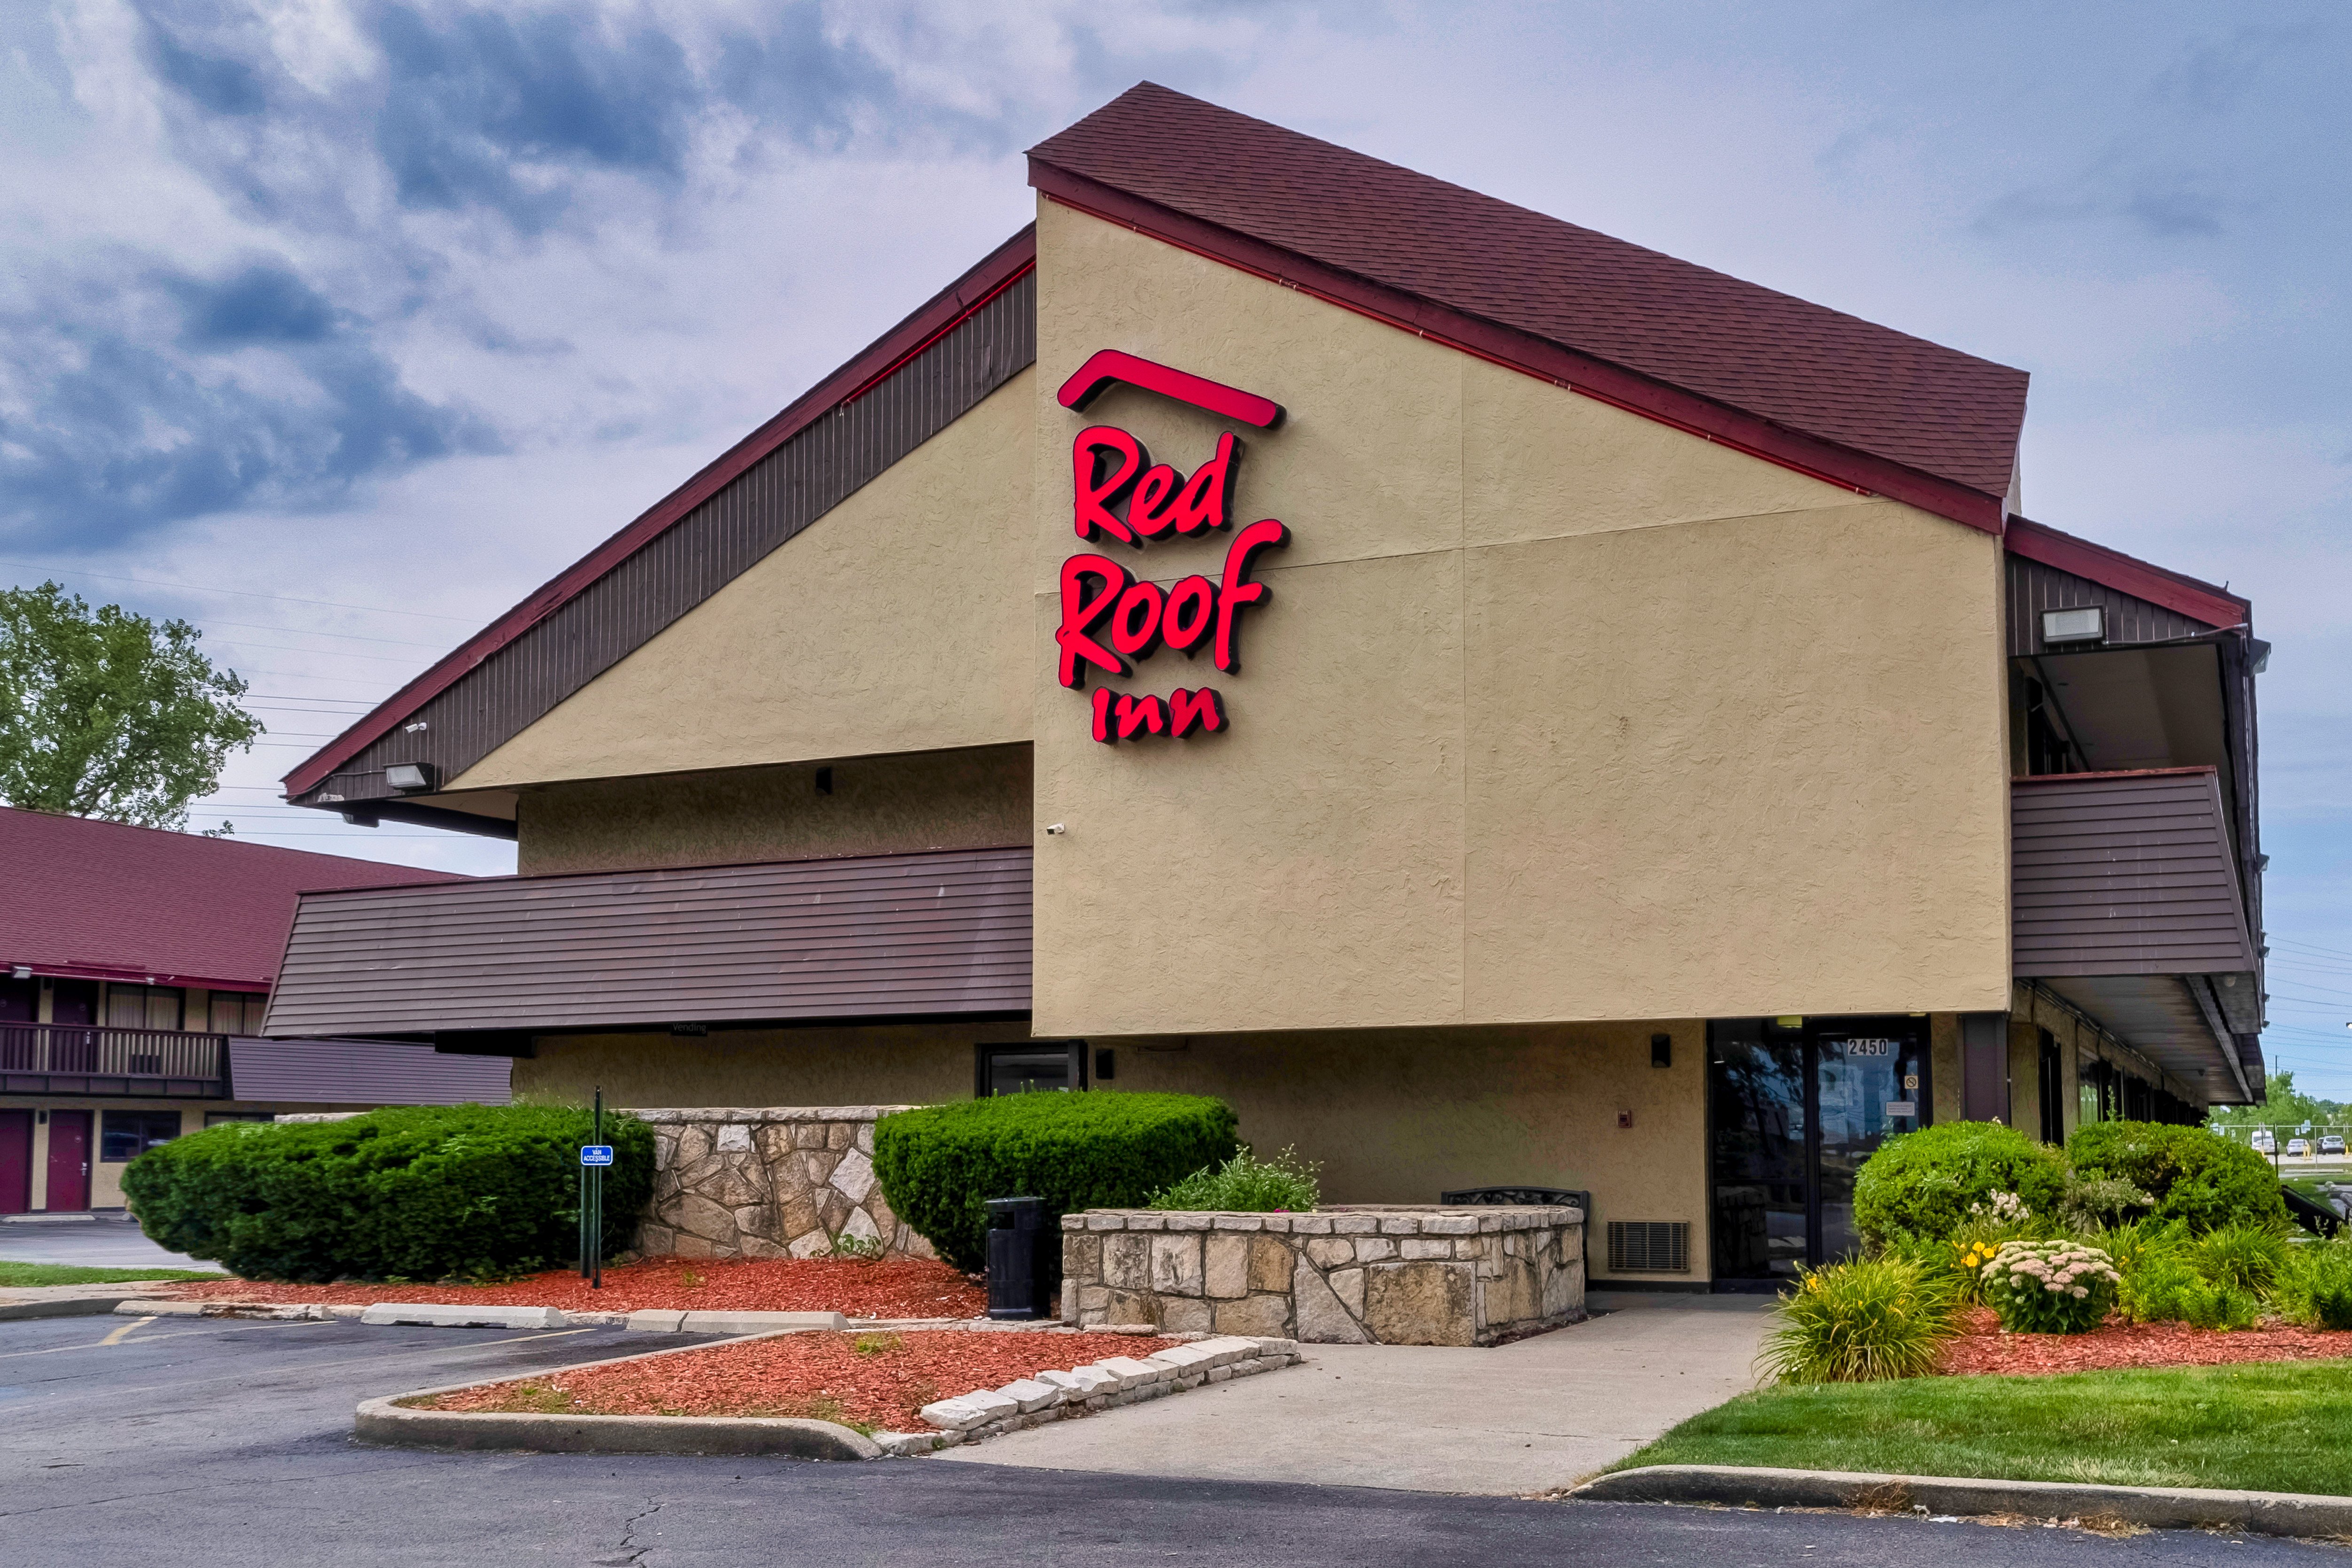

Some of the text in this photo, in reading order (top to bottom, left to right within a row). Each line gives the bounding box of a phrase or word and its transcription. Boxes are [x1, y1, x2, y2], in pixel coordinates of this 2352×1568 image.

[1073, 426, 1236, 544] Red
[1055, 519, 1284, 688] Roof
[673, 1023, 706, 1034] Vending
[1849, 1040, 1887, 1055] 2450
